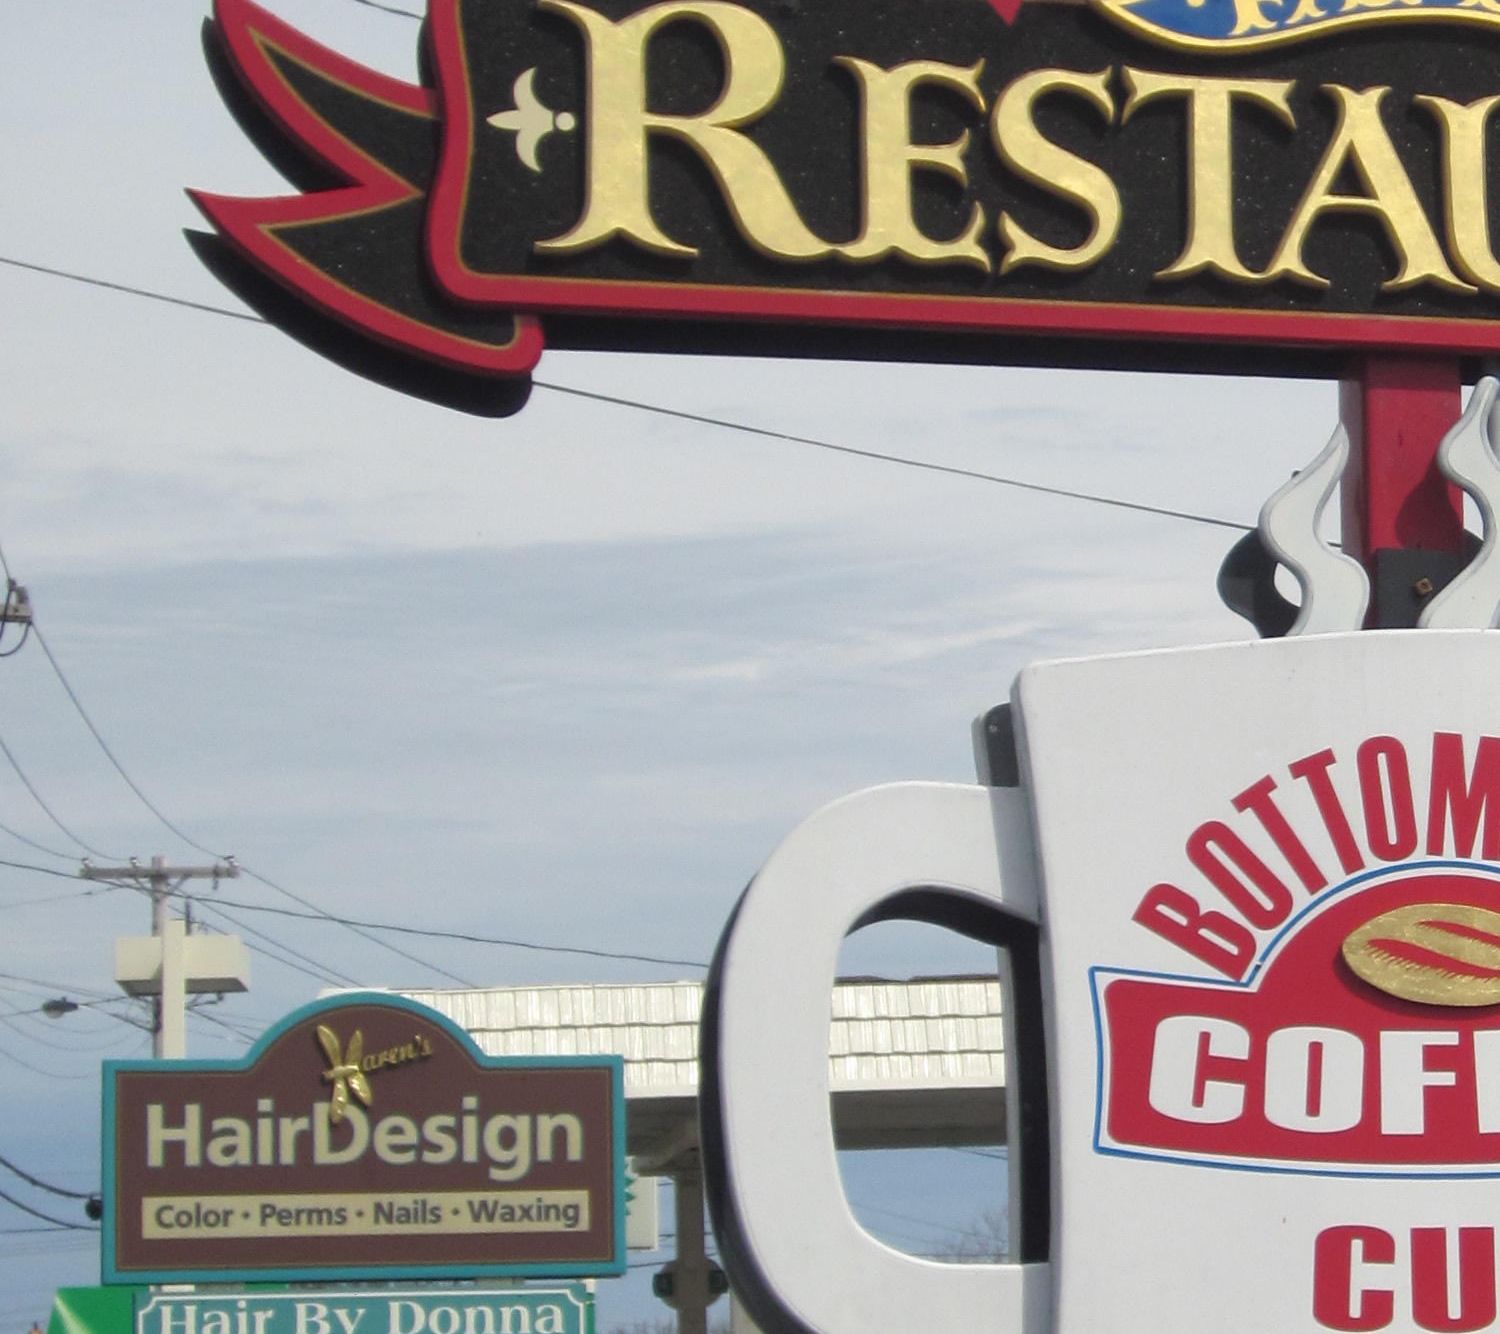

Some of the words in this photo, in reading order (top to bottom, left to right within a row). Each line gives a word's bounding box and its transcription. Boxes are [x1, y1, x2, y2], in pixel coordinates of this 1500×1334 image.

[154, 1201, 234, 1229] Color
[258, 1202, 348, 1227] Perms
[372, 1198, 442, 1225] Nails
[466, 1197, 580, 1229] Waxing
